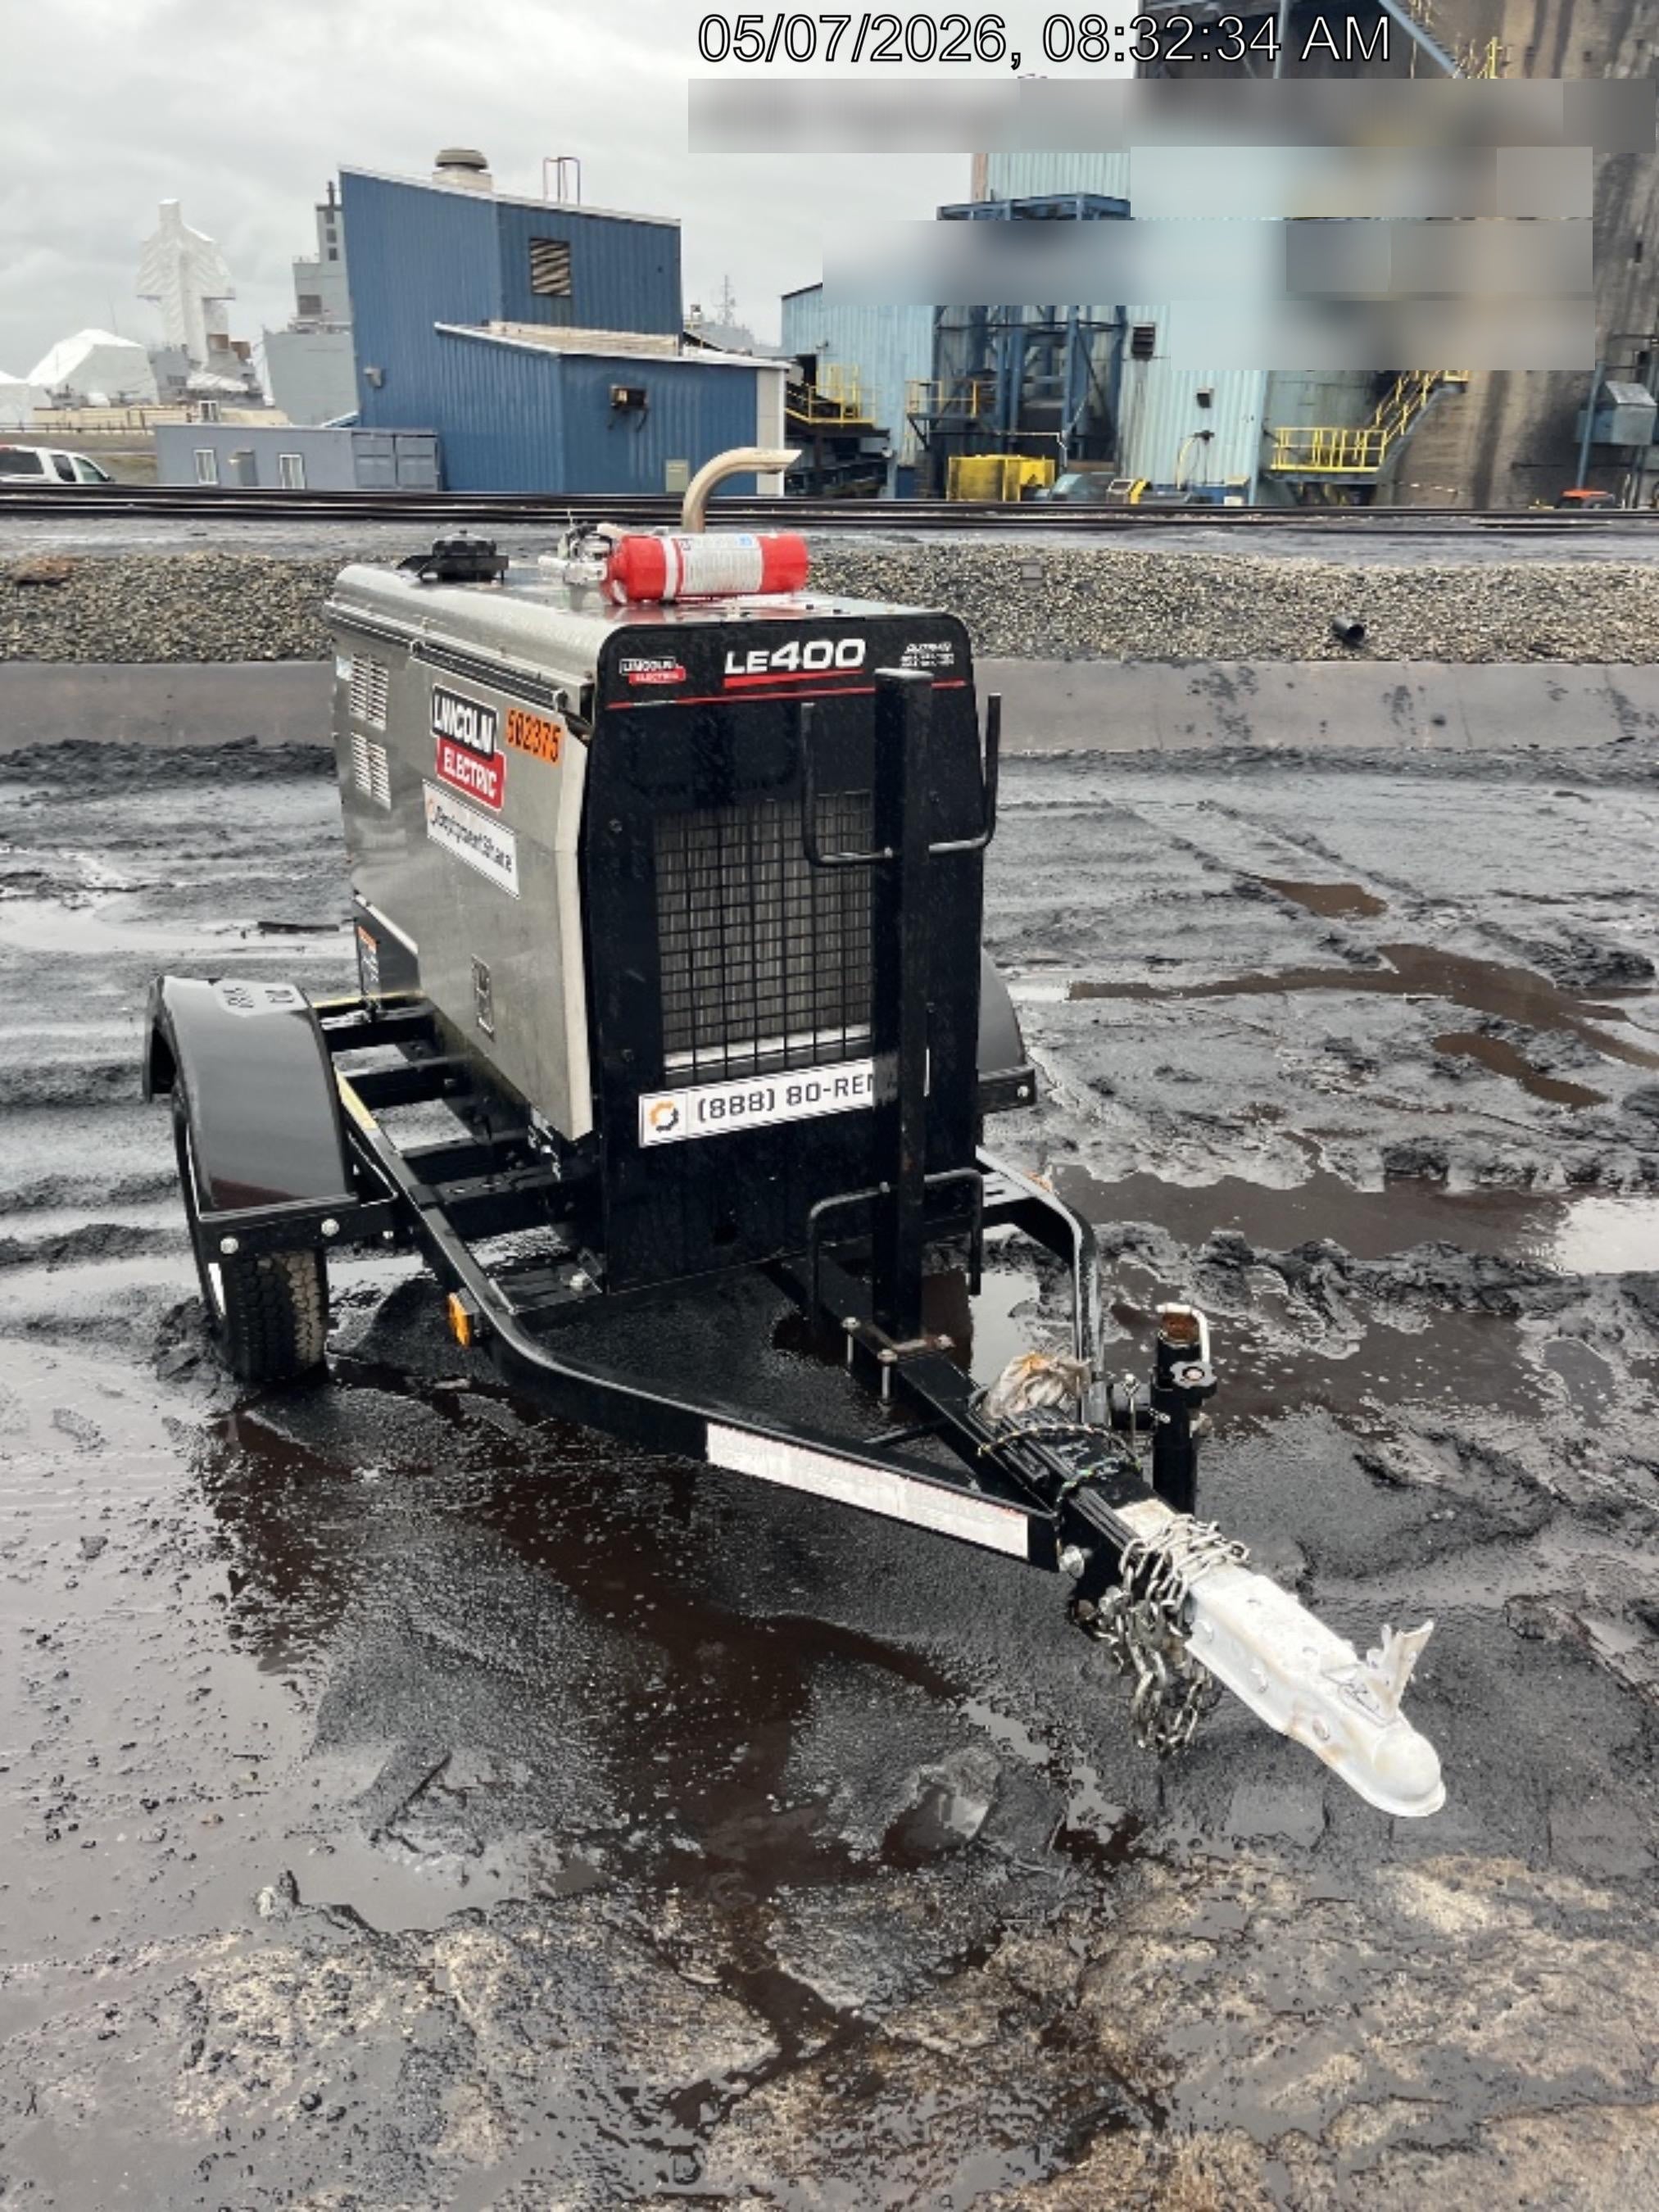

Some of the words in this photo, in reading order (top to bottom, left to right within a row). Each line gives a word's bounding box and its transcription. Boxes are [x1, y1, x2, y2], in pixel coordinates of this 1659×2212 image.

[723, 637, 867, 674] LE400
[433, 694, 493, 755] LINCOLN
[506, 709, 562, 764] 502375
[442, 746, 497, 799] ELECTRIC
[698, 1088, 775, 1123] (888)
